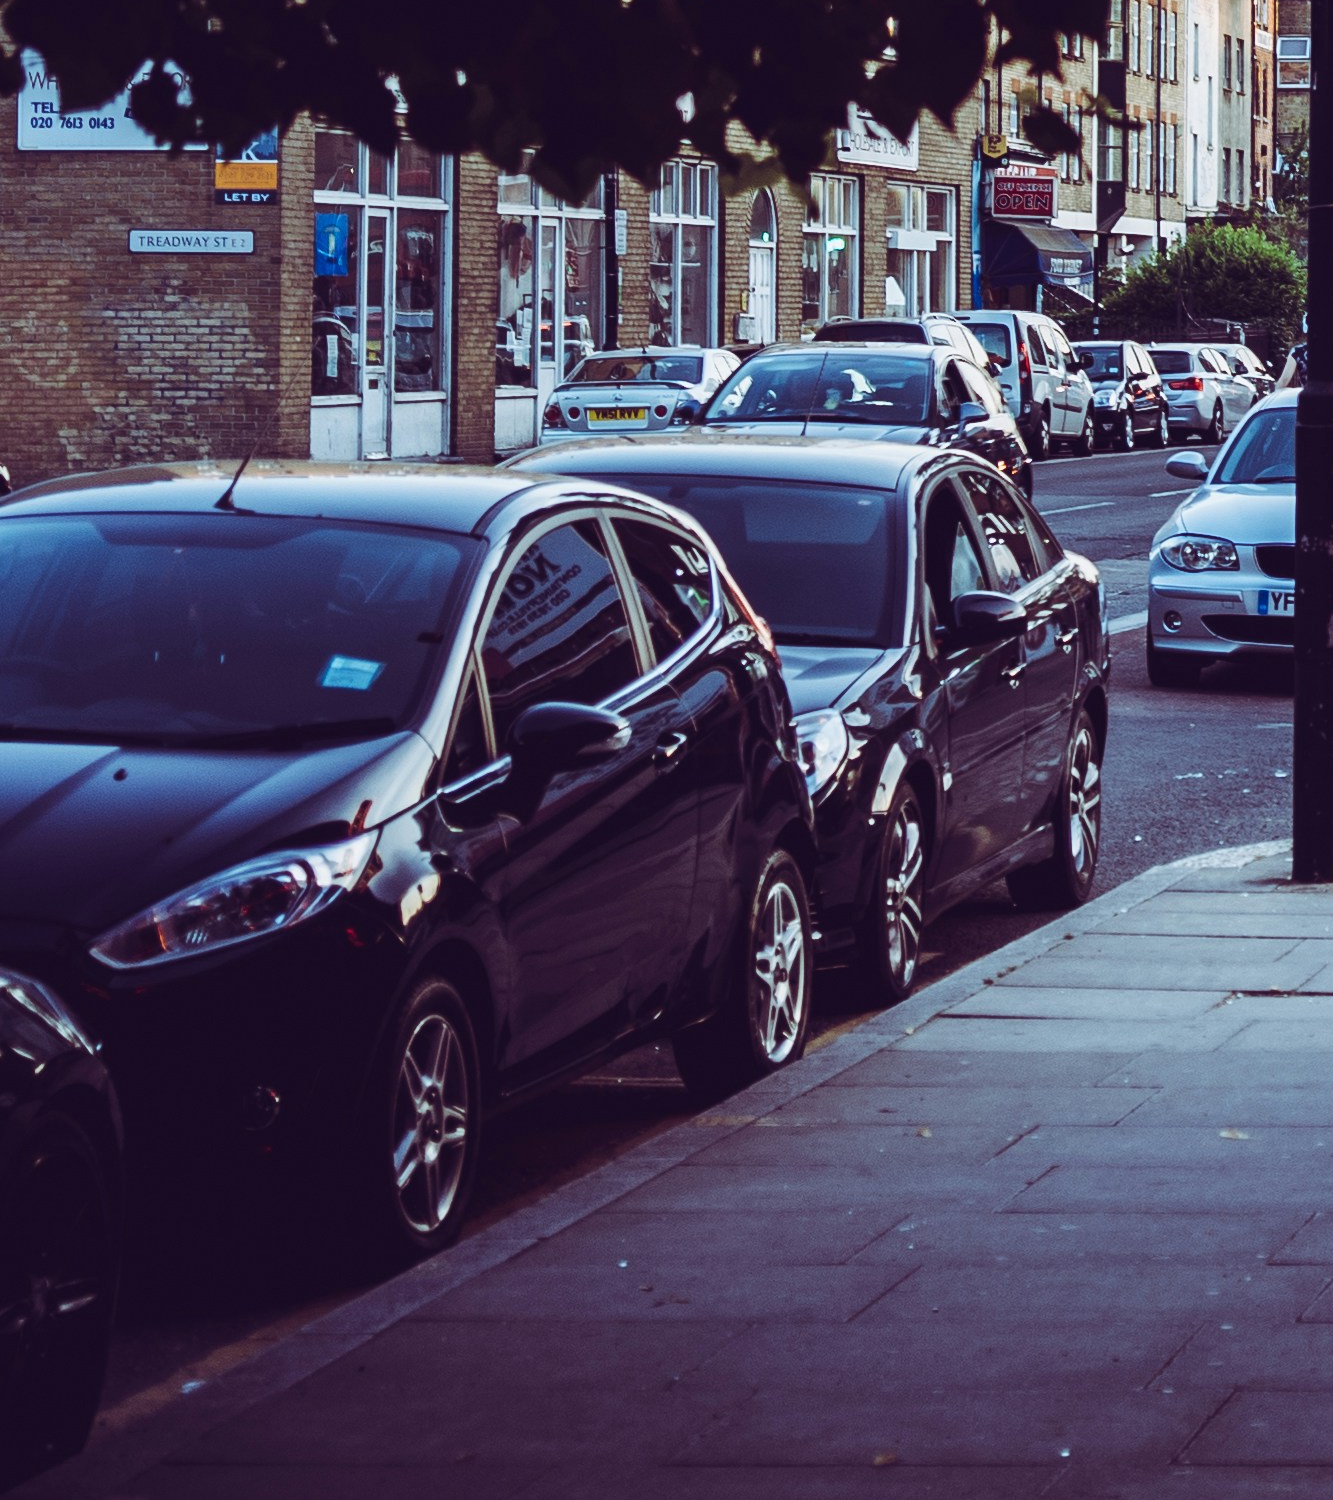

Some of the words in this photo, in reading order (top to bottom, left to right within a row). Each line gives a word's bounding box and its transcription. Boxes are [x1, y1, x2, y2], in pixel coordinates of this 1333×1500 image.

[31, 102, 59, 114] TEL
[30, 116, 53, 129] 020
[59, 116, 83, 129] 7613
[88, 116, 115, 129] 0143
[224, 193, 248, 201] LET
[251, 193, 269, 201] BY
[995, 194, 1050, 210] OPEN
[138, 236, 209, 248] TREADWAY
[213, 237, 228, 248] ST
